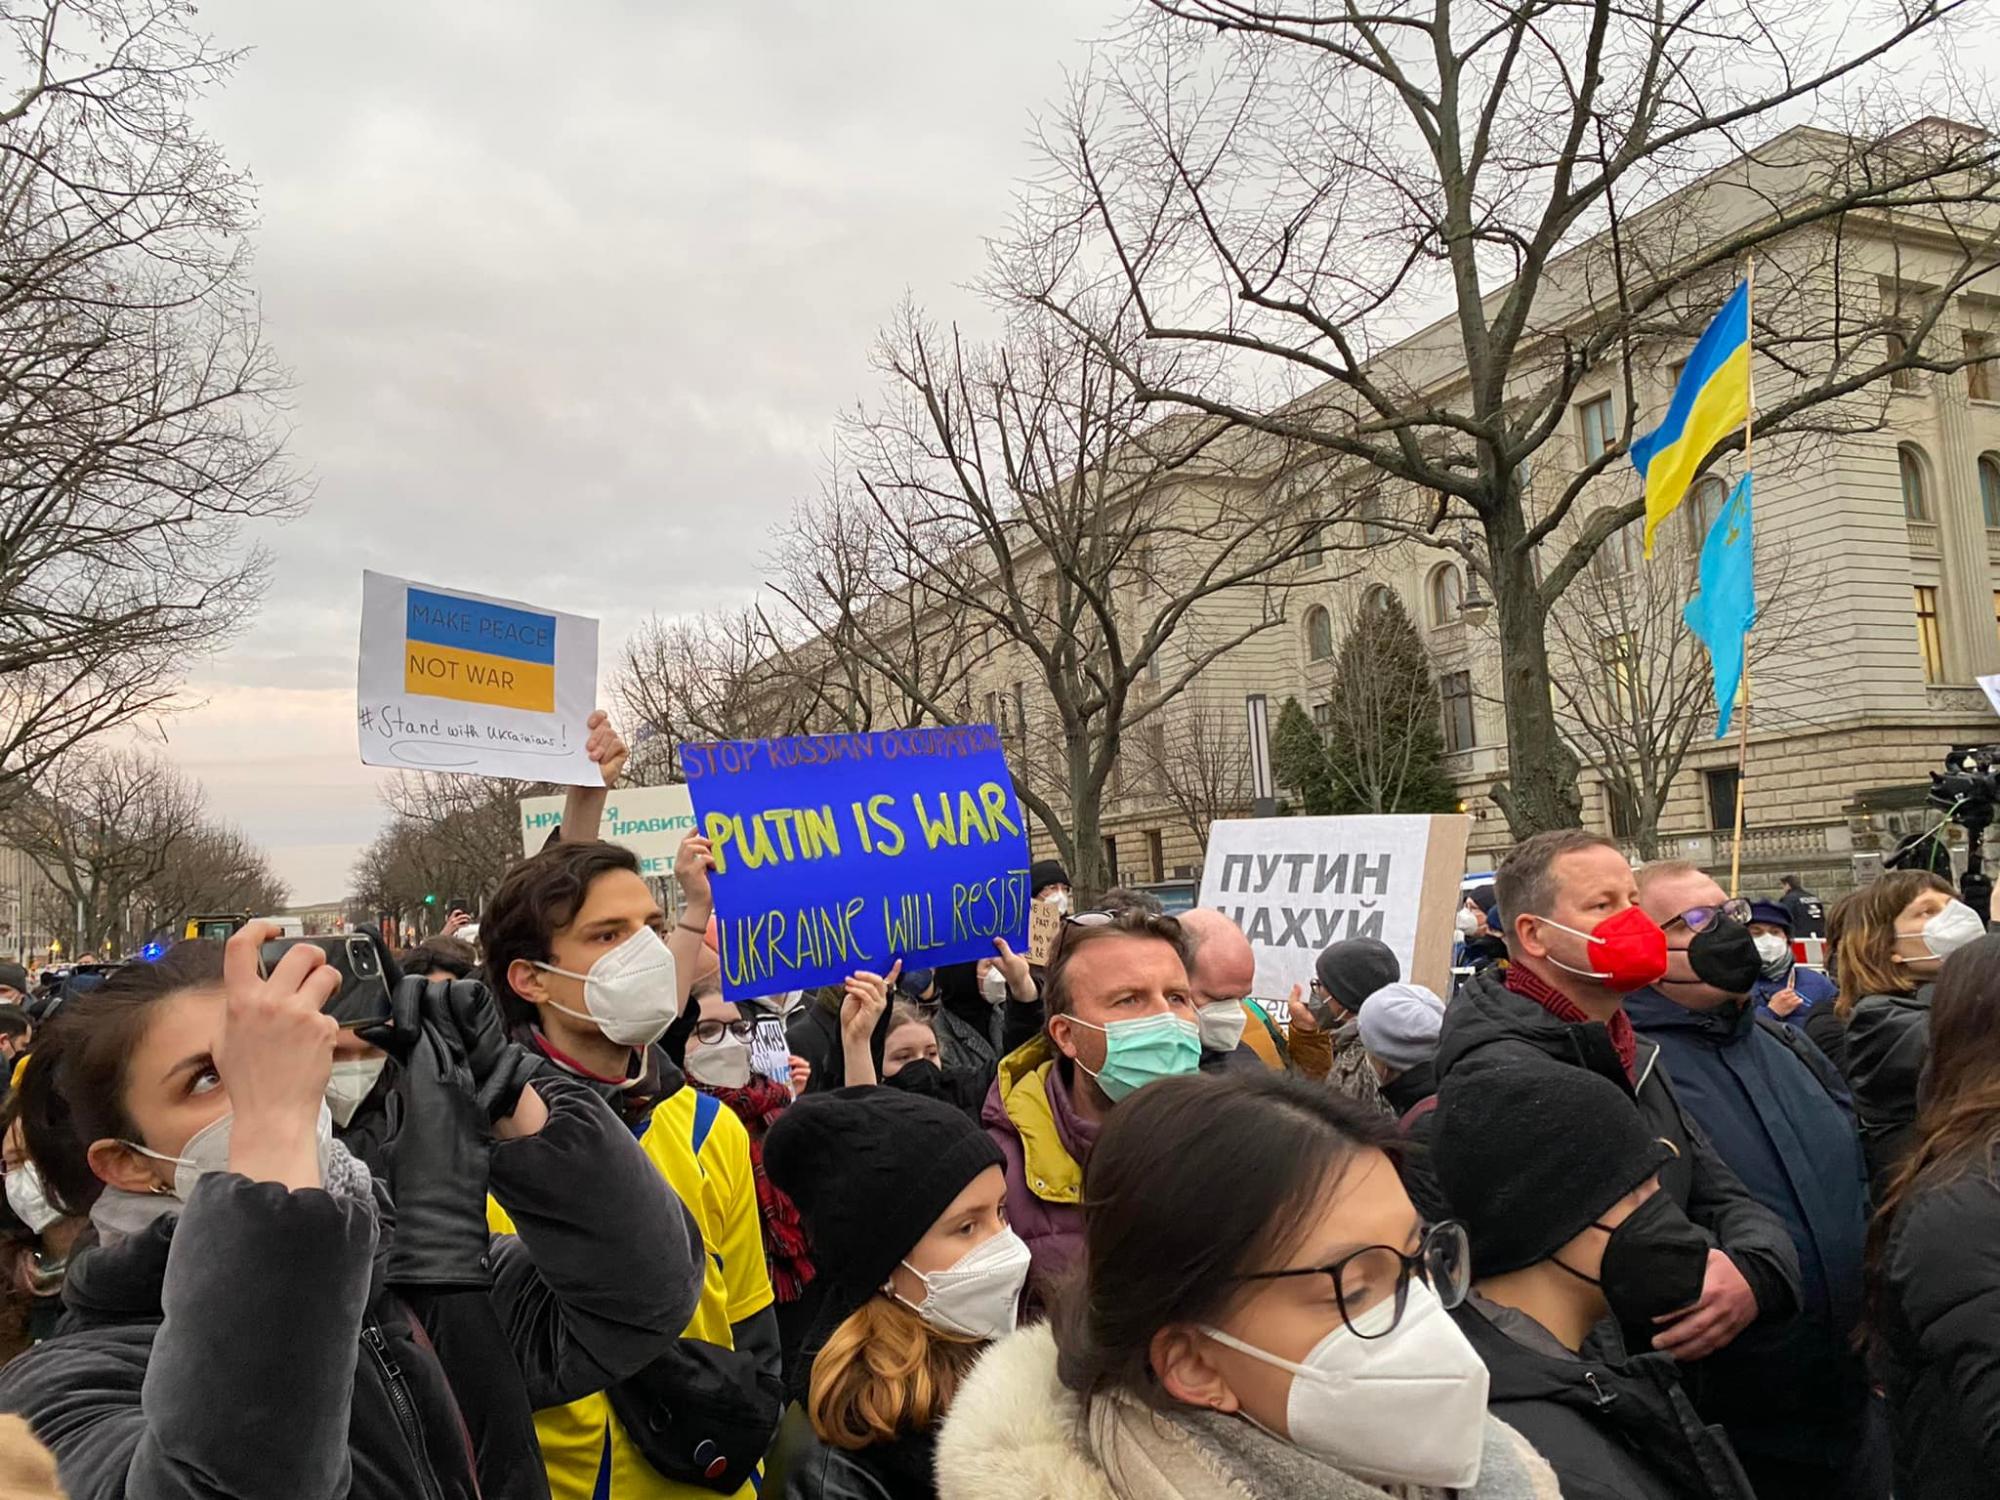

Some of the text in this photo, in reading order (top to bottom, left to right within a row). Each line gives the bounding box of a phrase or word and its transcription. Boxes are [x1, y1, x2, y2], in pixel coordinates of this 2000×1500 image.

[412, 603, 548, 648] MAKE PEACE
[410, 654, 514, 690] NOT WAR
[447, 721, 479, 738] with
[683, 742, 758, 779] STOP
[767, 734, 874, 770] RUSSIAN
[705, 782, 1020, 875] PUTIN IS WAR
[1220, 853, 1392, 896] ПУТИН
[884, 893, 946, 954] WILL
